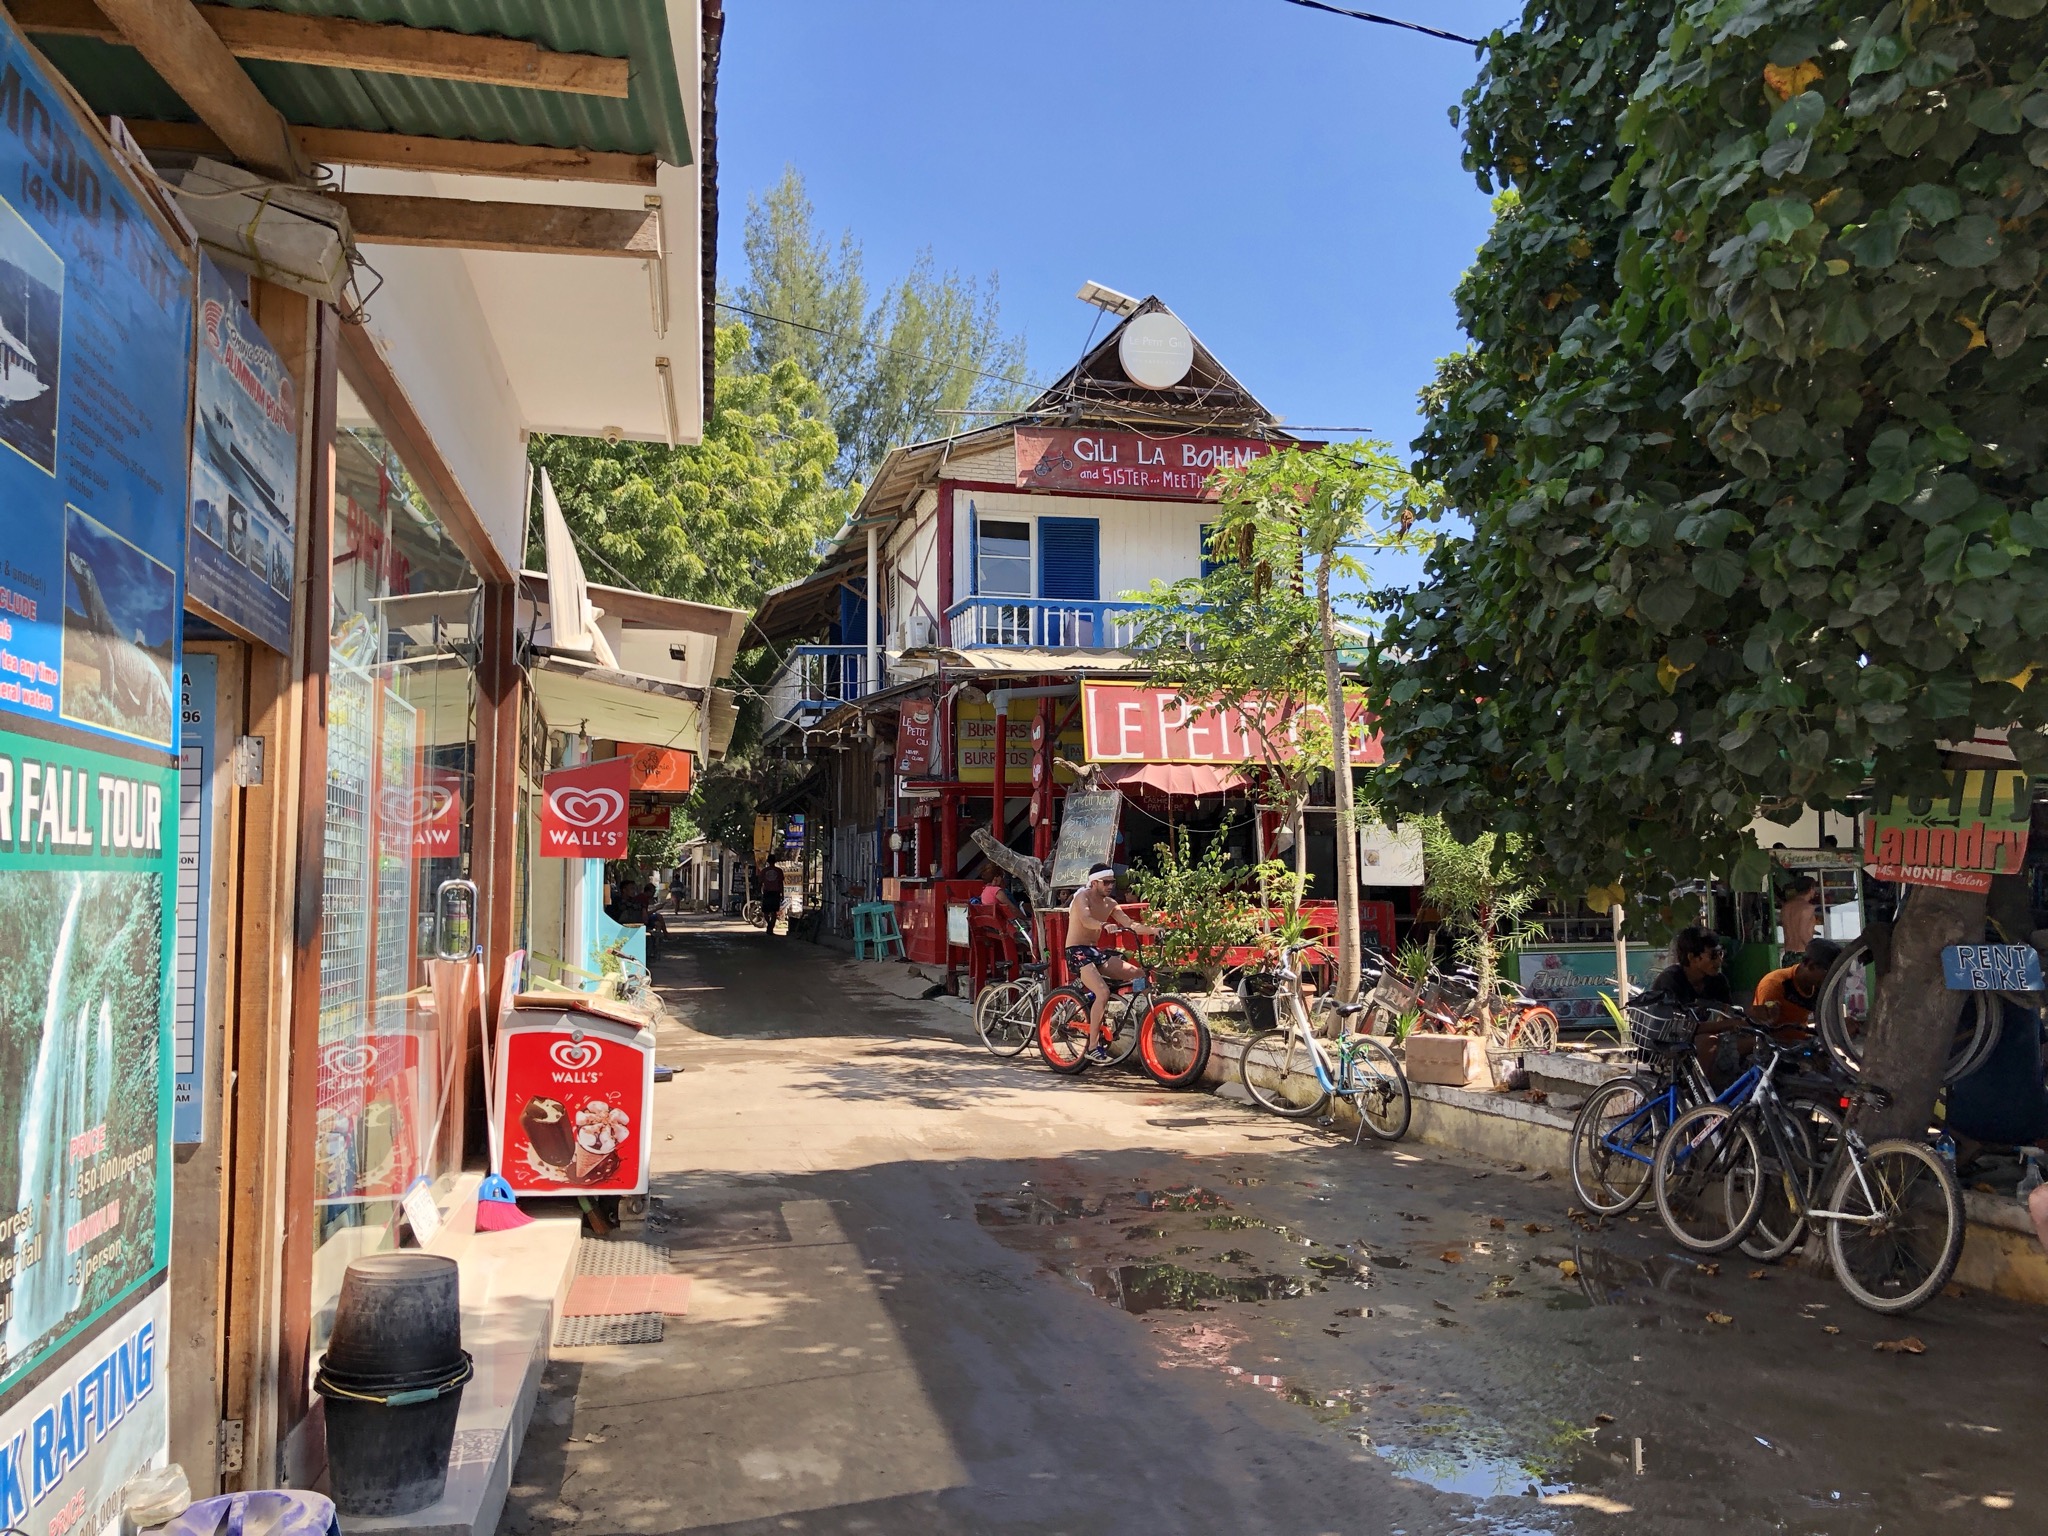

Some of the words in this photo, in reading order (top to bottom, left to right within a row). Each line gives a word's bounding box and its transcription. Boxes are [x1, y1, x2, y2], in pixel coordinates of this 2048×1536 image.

[1137, 441, 1165, 465] LA
[1080, 469, 1100, 480] and
[967, 721, 1027, 739] BURERS
[1085, 688, 1144, 760] LE
[20, 757, 93, 856] FALL
[98, 772, 162, 858] TOUR
[549, 829, 617, 847] WALL'S
[1863, 819, 2027, 871] Laundry
[1957, 945, 2027, 970] RENT
[1971, 968, 2031, 990] BIKE
[551, 1071, 599, 1084] WALL'S
[84, 1238, 122, 1284] person
[31, 1317, 154, 1508] RAFTING
